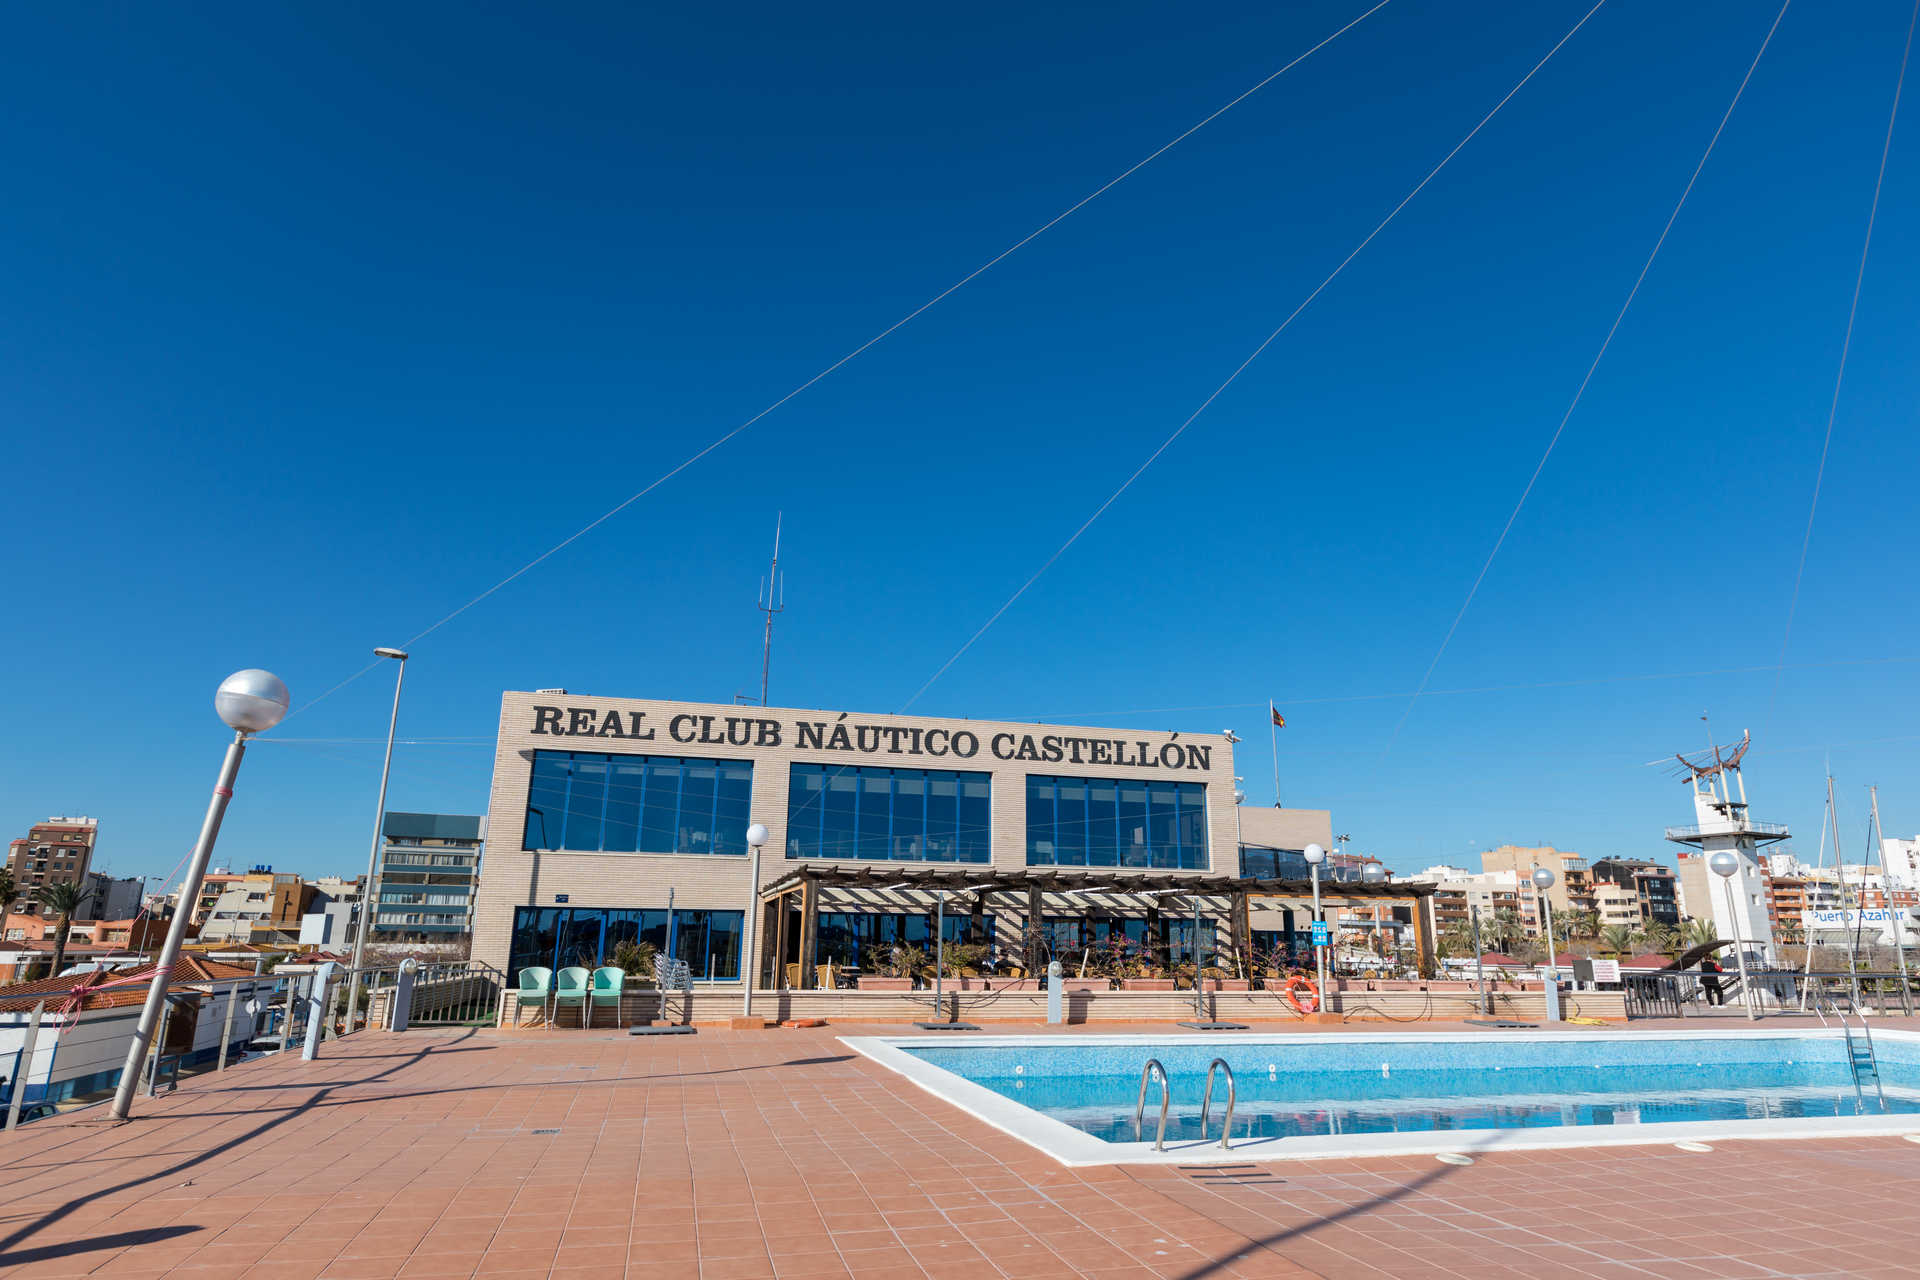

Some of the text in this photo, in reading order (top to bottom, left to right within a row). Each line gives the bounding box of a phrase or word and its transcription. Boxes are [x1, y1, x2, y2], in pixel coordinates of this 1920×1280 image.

[530, 705, 1212, 770] REAL CLUB NÁUTICO CASTELLÓN
